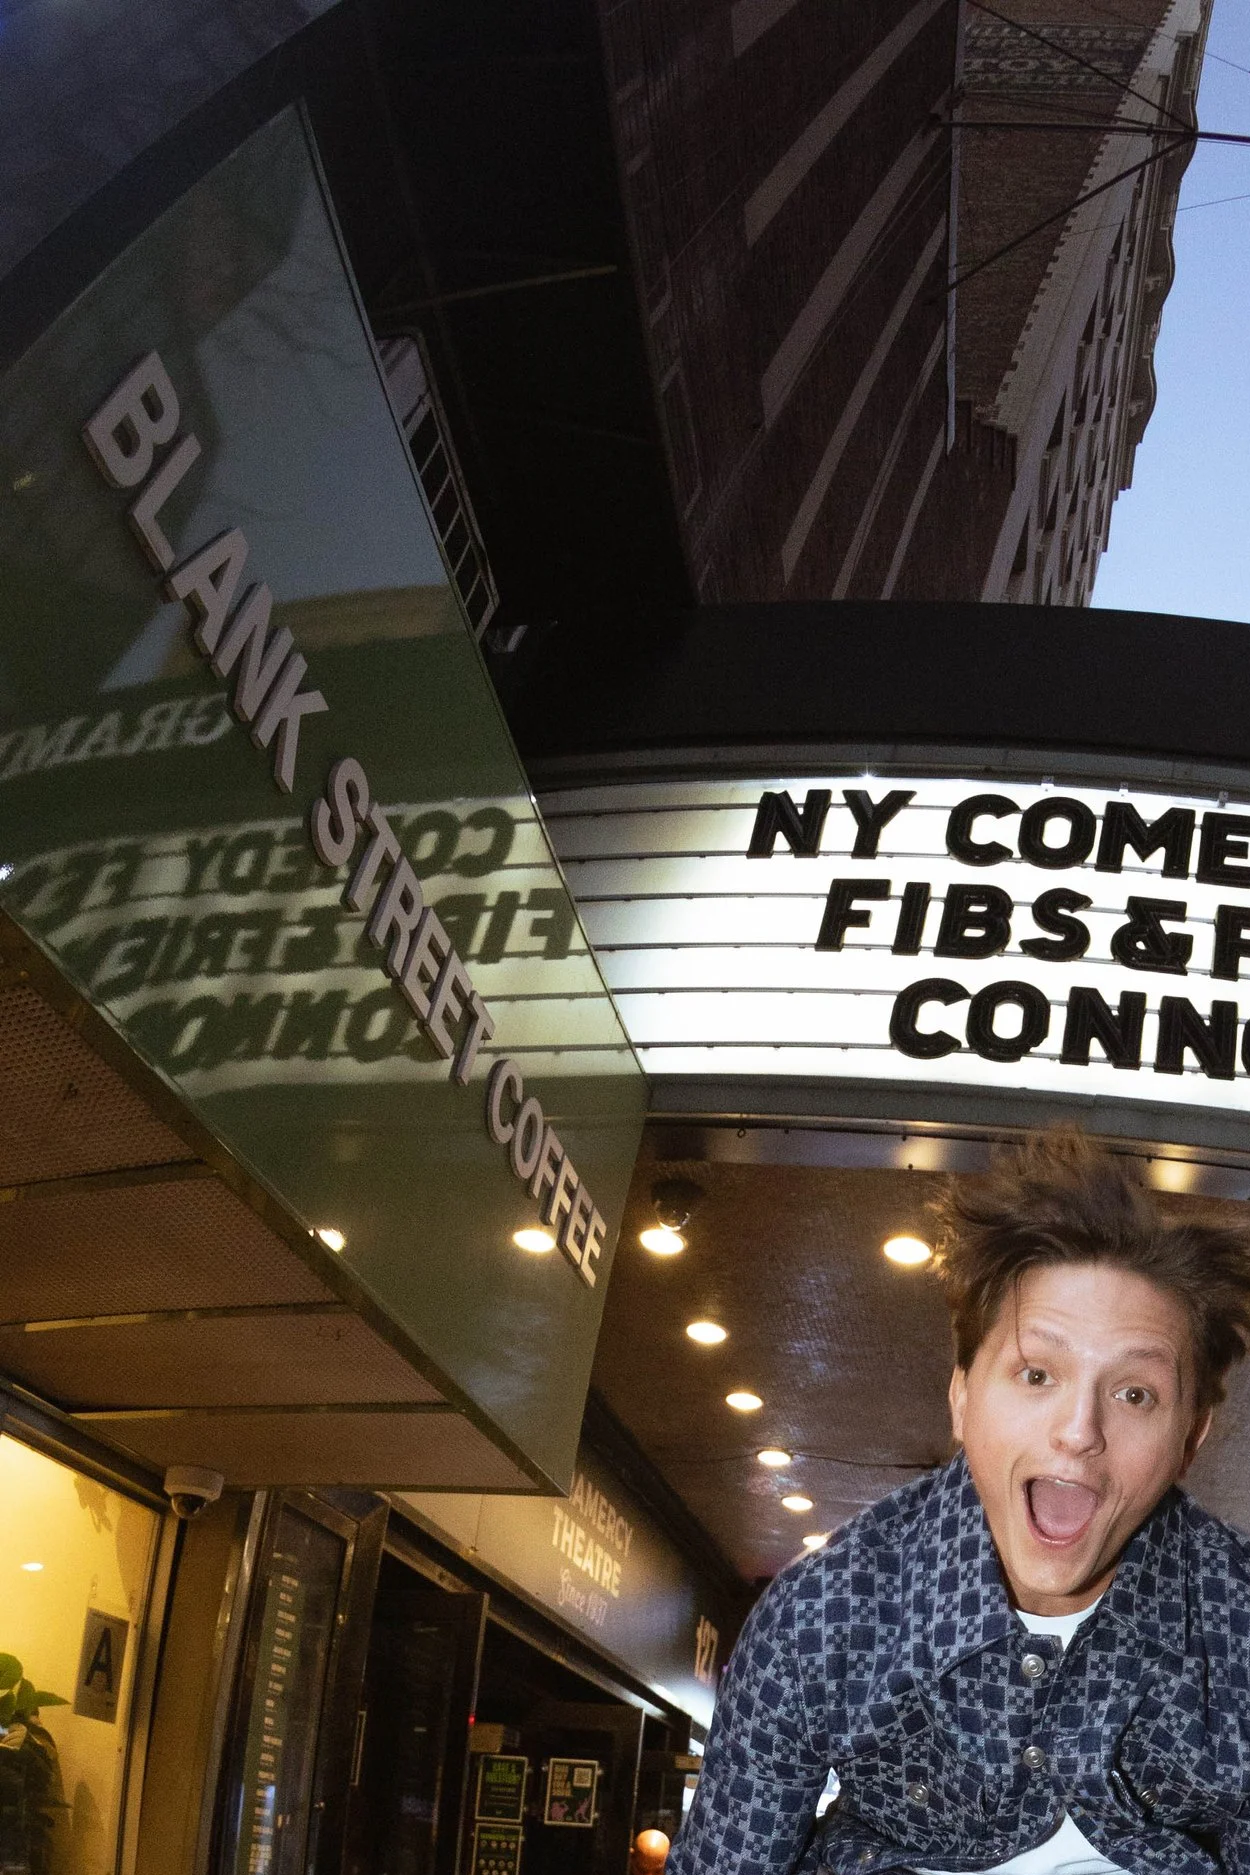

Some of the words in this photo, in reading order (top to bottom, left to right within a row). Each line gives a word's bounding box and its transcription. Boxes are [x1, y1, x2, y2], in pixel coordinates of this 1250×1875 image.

[82, 349, 329, 793] BLANK
[310, 757, 496, 1086] STREET
[487, 1059, 607, 1288] COFFEE
[746, 788, 917, 860] NY
[552, 1504, 622, 1598] THEATRE
[84, 1627, 113, 1694] A
